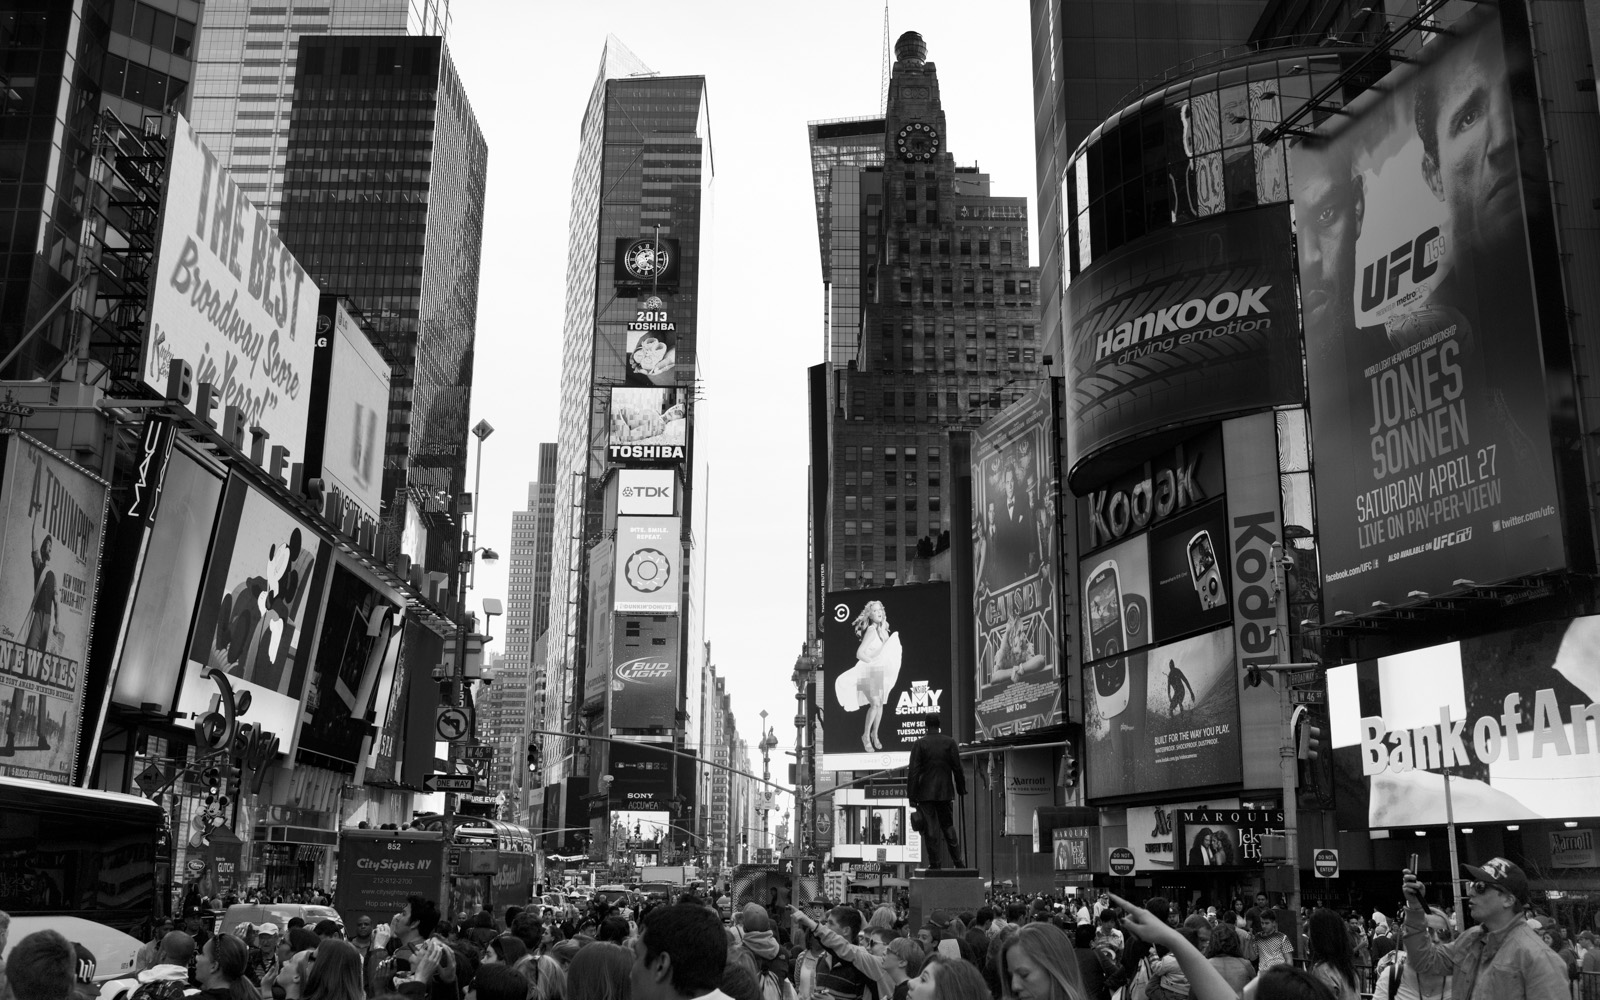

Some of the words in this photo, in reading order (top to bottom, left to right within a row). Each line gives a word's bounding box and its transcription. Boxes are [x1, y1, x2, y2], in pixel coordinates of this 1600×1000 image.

[248, 207, 304, 342] BEST
[1361, 226, 1440, 313] UFC
[1426, 235, 1447, 264] 159
[170, 236, 264, 379] Broadway
[262, 329, 301, 400] Score
[637, 311, 668, 322] 2013
[628, 322, 675, 331] TOSHIBA
[1117, 338, 1174, 366] driving
[1178, 318, 1271, 345] emotion
[1364, 363, 1380, 378] WORLD
[1379, 358, 1391, 372] LIGHT
[1391, 343, 1422, 366] HEAVYWEIGHT
[1421, 324, 1457, 350] CHAMPIONSHIP
[197, 342, 219, 385] in
[1369, 339, 1464, 435] JONES
[1409, 407, 1416, 418] VS
[1370, 399, 1470, 480] SONNEN
[609, 445, 684, 458] TOSHIBA
[1356, 471, 1424, 523] SATURDAY
[1429, 454, 1476, 498] APRIL
[1477, 444, 1497, 479] 27
[633, 486, 670, 498] TDK
[1088, 452, 1208, 548] Kodak
[1358, 518, 1386, 550] LIVE
[1387, 511, 1404, 540] ON
[1407, 478, 1502, 534] PAY-PER-VIEW
[1501, 505, 1555, 529] twitter.com/ufc
[1388, 551, 1400, 563] ALSO
[1400, 545, 1425, 559] AVAILABLE
[1425, 542, 1433, 551] ON
[1325, 561, 1373, 583] facebook.com/UFC
[63, 573, 73, 589] NEW
[985, 577, 1044, 628] GATSBY
[1232, 510, 1280, 691] Kodak
[1, 624, 15, 639] Disney
[0, 639, 79, 690] NEWSIES
[631, 662, 670, 671] BUD
[622, 669, 673, 678] LIGHT
[913, 684, 927, 694] INSIDE
[896, 689, 943, 708] AMY
[1306, 692, 1315, 702] 46
[895, 705, 941, 715] SCHUMER
[1006, 703, 1015, 713] MAY
[1014, 703, 1020, 711] 10
[897, 728, 926, 736] TUESDAYS
[1154, 735, 1167, 746] BUILT
[1168, 734, 1178, 743] FOR
[1179, 732, 1190, 741] THE
[1190, 730, 1202, 739] WAY
[1202, 728, 1215, 737] YOU
[1215, 724, 1230, 735] PLAY.
[1359, 704, 1471, 777] Bank
[1472, 692, 1522, 765] of
[1198, 737, 1219, 747] DUSTPROOF.
[467, 748, 473, 756] W
[474, 747, 484, 757] 46
[1011, 777, 1045, 786] Marriott
[872, 788, 907, 797] Broadway
[1184, 812, 1284, 823] MARQUIS
[1053, 828, 1088, 838] MARQUIS
[387, 842, 401, 850] 852
[1551, 832, 1592, 854] Marriott
[356, 858, 415, 871] CitySights
[417, 859, 432, 870] NY
[365, 901, 379, 909] Hop
